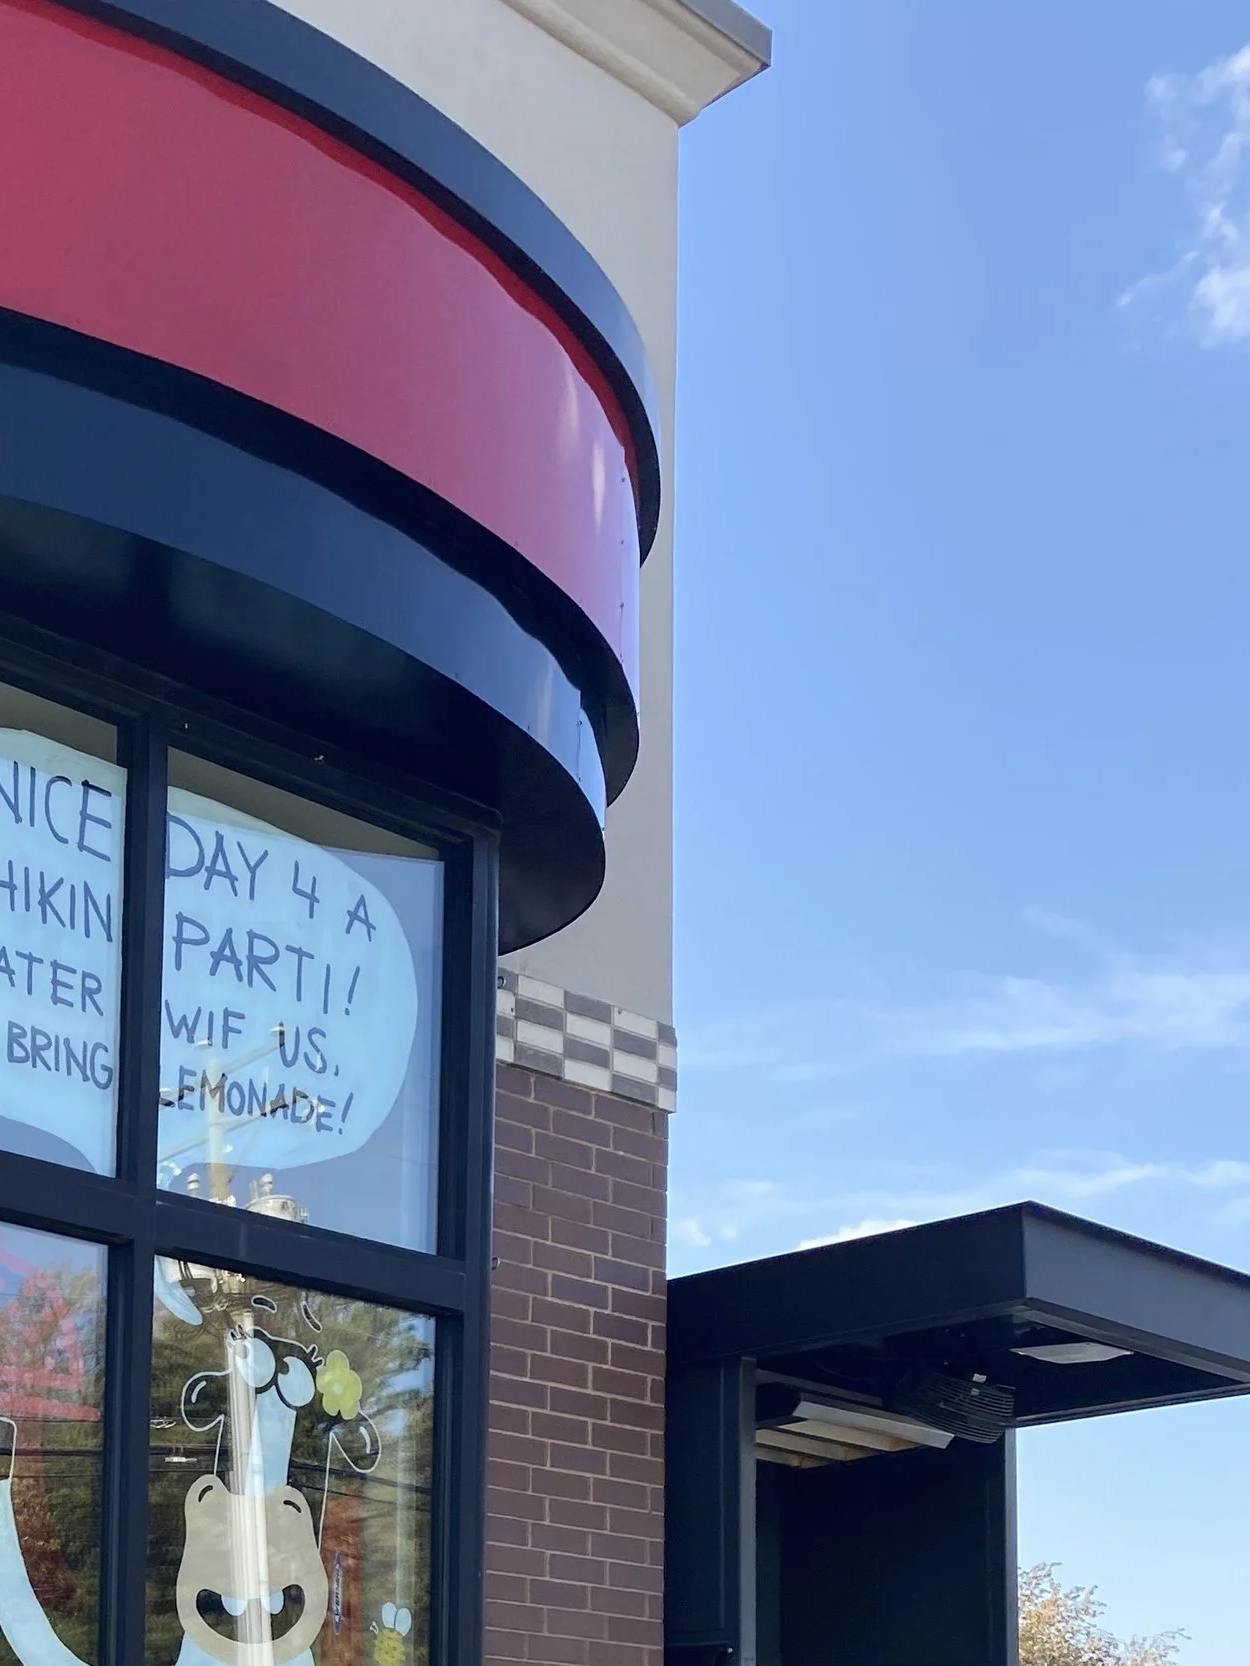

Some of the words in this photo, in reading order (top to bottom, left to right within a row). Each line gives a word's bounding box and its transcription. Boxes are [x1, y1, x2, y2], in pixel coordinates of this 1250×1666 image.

[165, 812, 269, 900] DAY
[292, 860, 320, 919] 4
[345, 894, 376, 942] A
[172, 911, 360, 1016] PARTI!
[7, 1020, 114, 1090] BRING
[165, 999, 246, 1049] WIF
